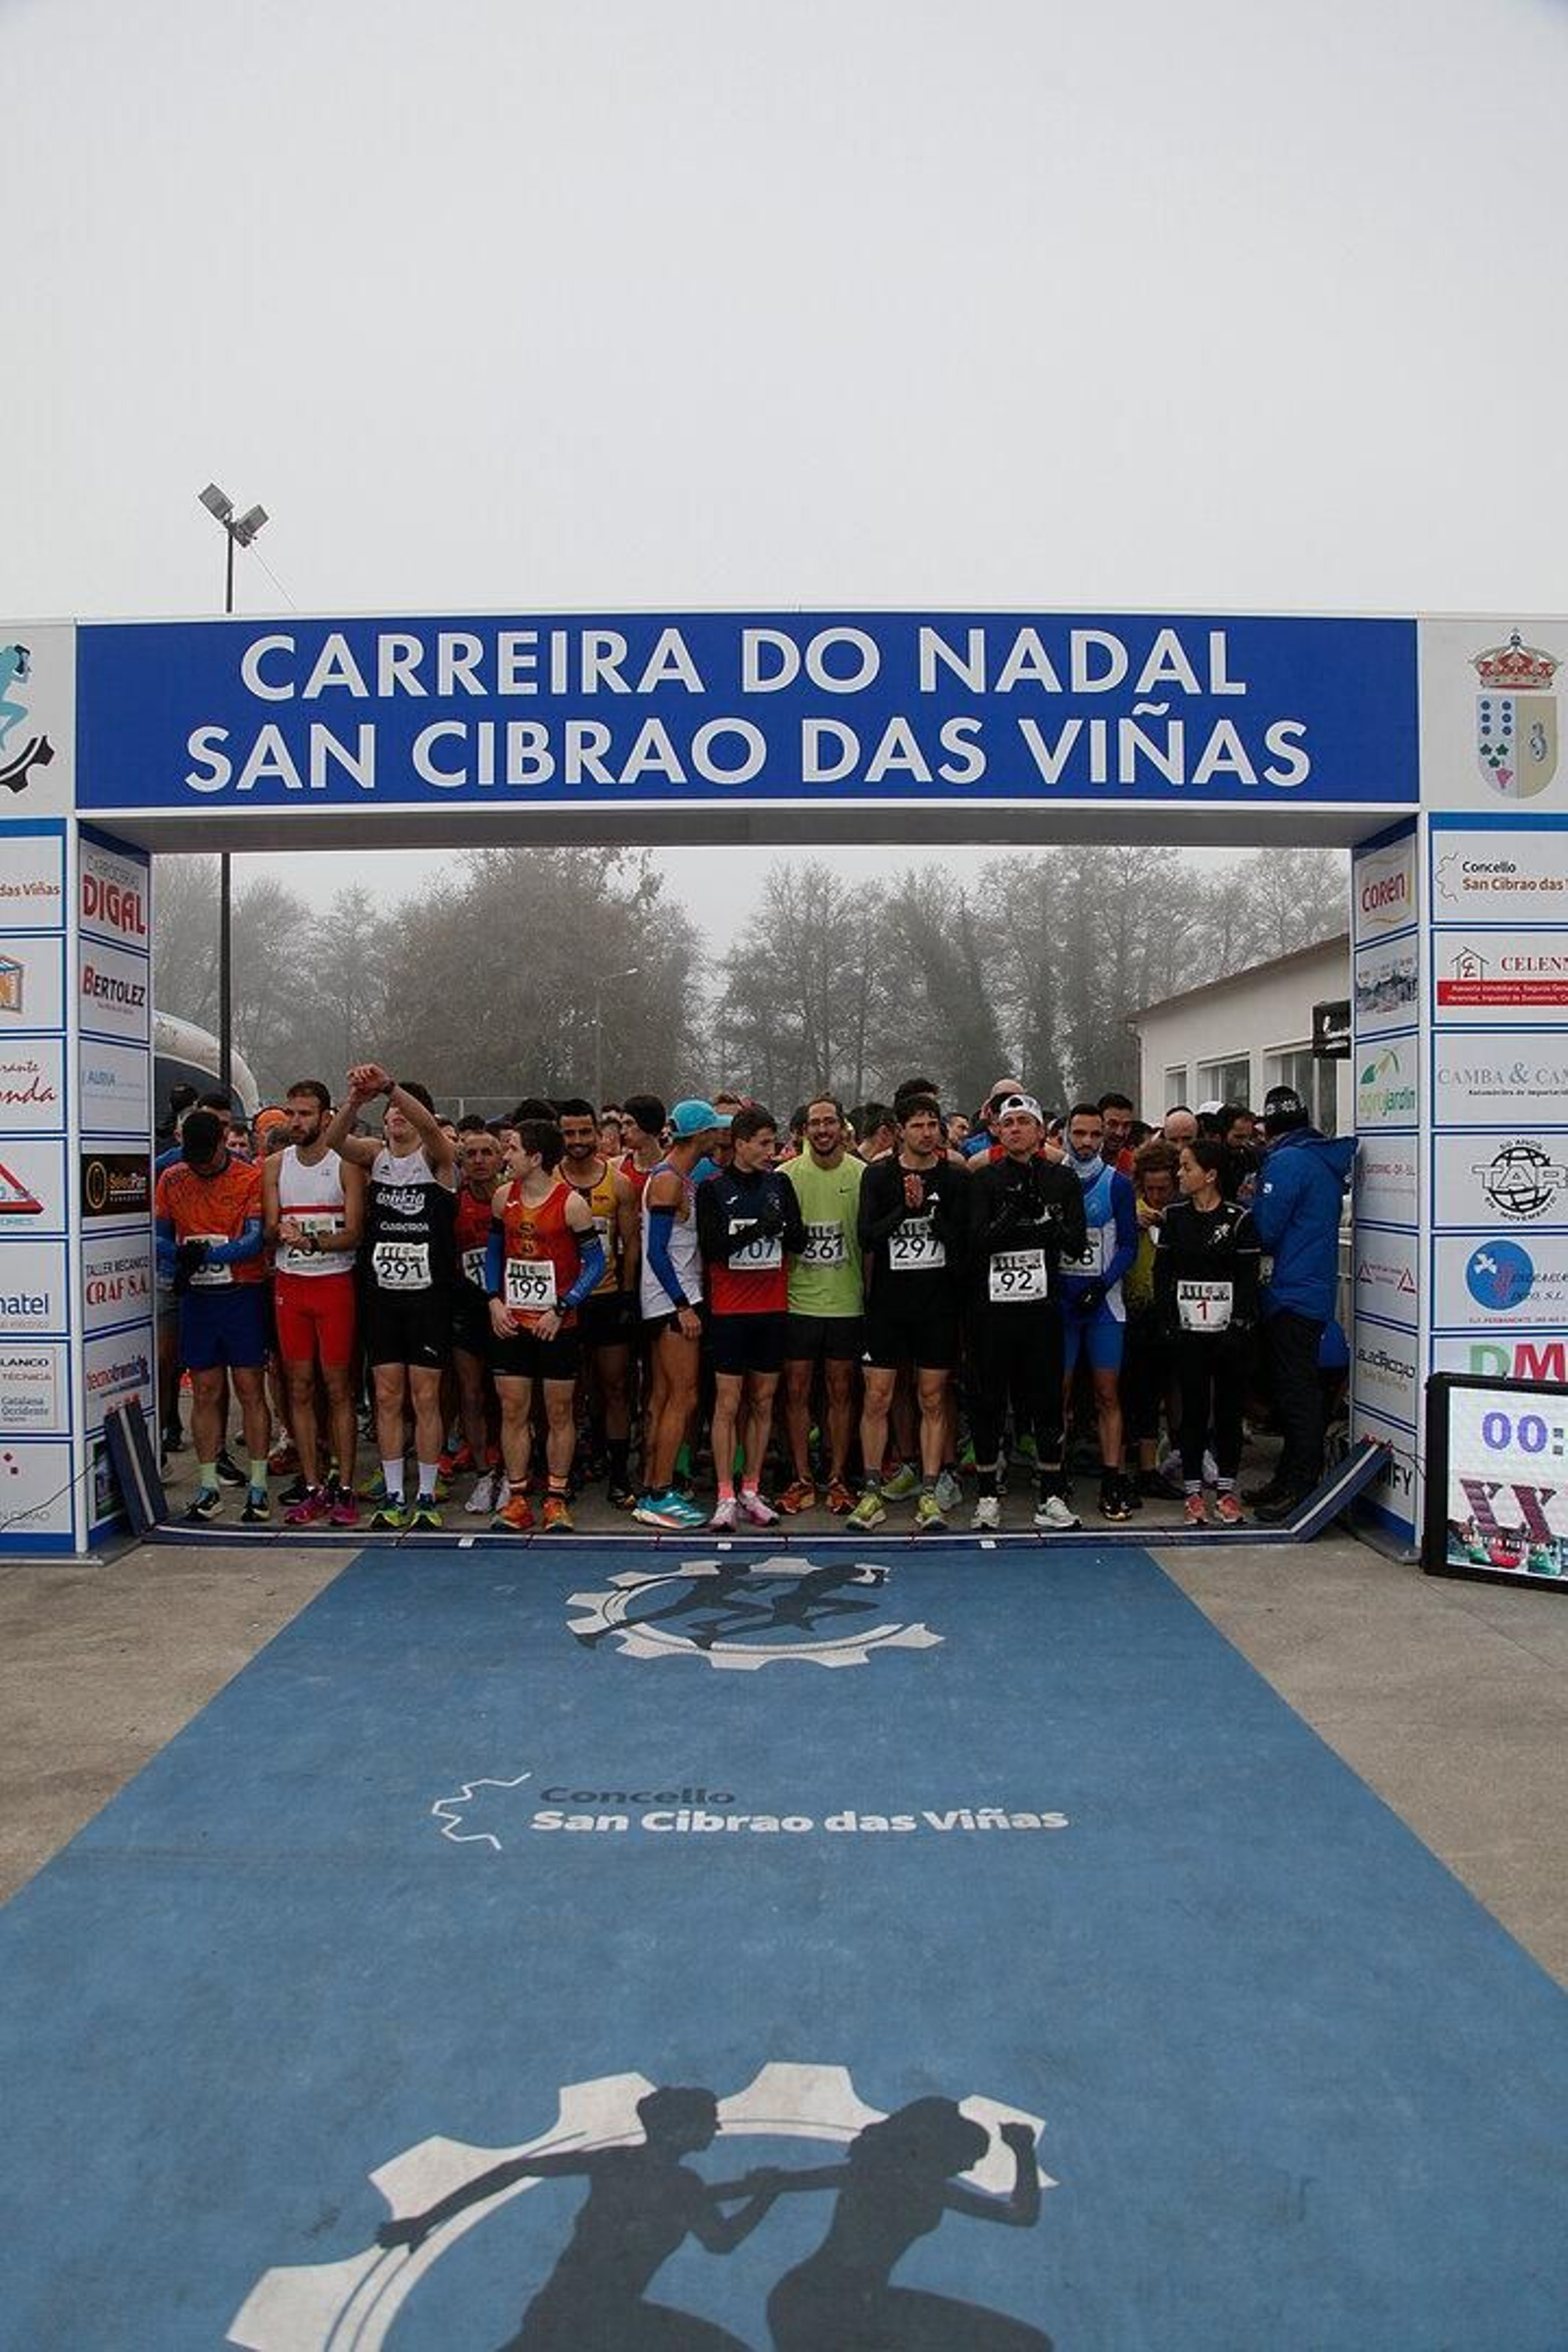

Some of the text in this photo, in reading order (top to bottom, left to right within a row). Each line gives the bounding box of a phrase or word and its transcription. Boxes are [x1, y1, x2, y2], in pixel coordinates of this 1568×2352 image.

[240, 627, 1247, 701] CARREIRA DO NADAL
[185, 703, 1311, 793] SAN CIBRAO DAS VIÑAS
[1461, 861, 1517, 874] Concello
[0, 881, 61, 897] das Viñas
[1462, 878, 1564, 891] San Cibrao das
[82, 873, 147, 935] DIGAL
[82, 964, 147, 1007] BERTOLEZ
[1438, 1068, 1503, 1084] CAMBA
[1509, 1061, 1530, 1084] &
[894, 1238, 939, 1259] 297
[378, 1262, 422, 1281] 291
[1000, 1270, 1033, 1292] 92
[509, 1278, 548, 1300] 199
[1197, 1300, 1207, 1321] 1
[540, 1786, 736, 1806] Concello
[529, 1808, 1070, 1835] San Cibrao das Viñas
